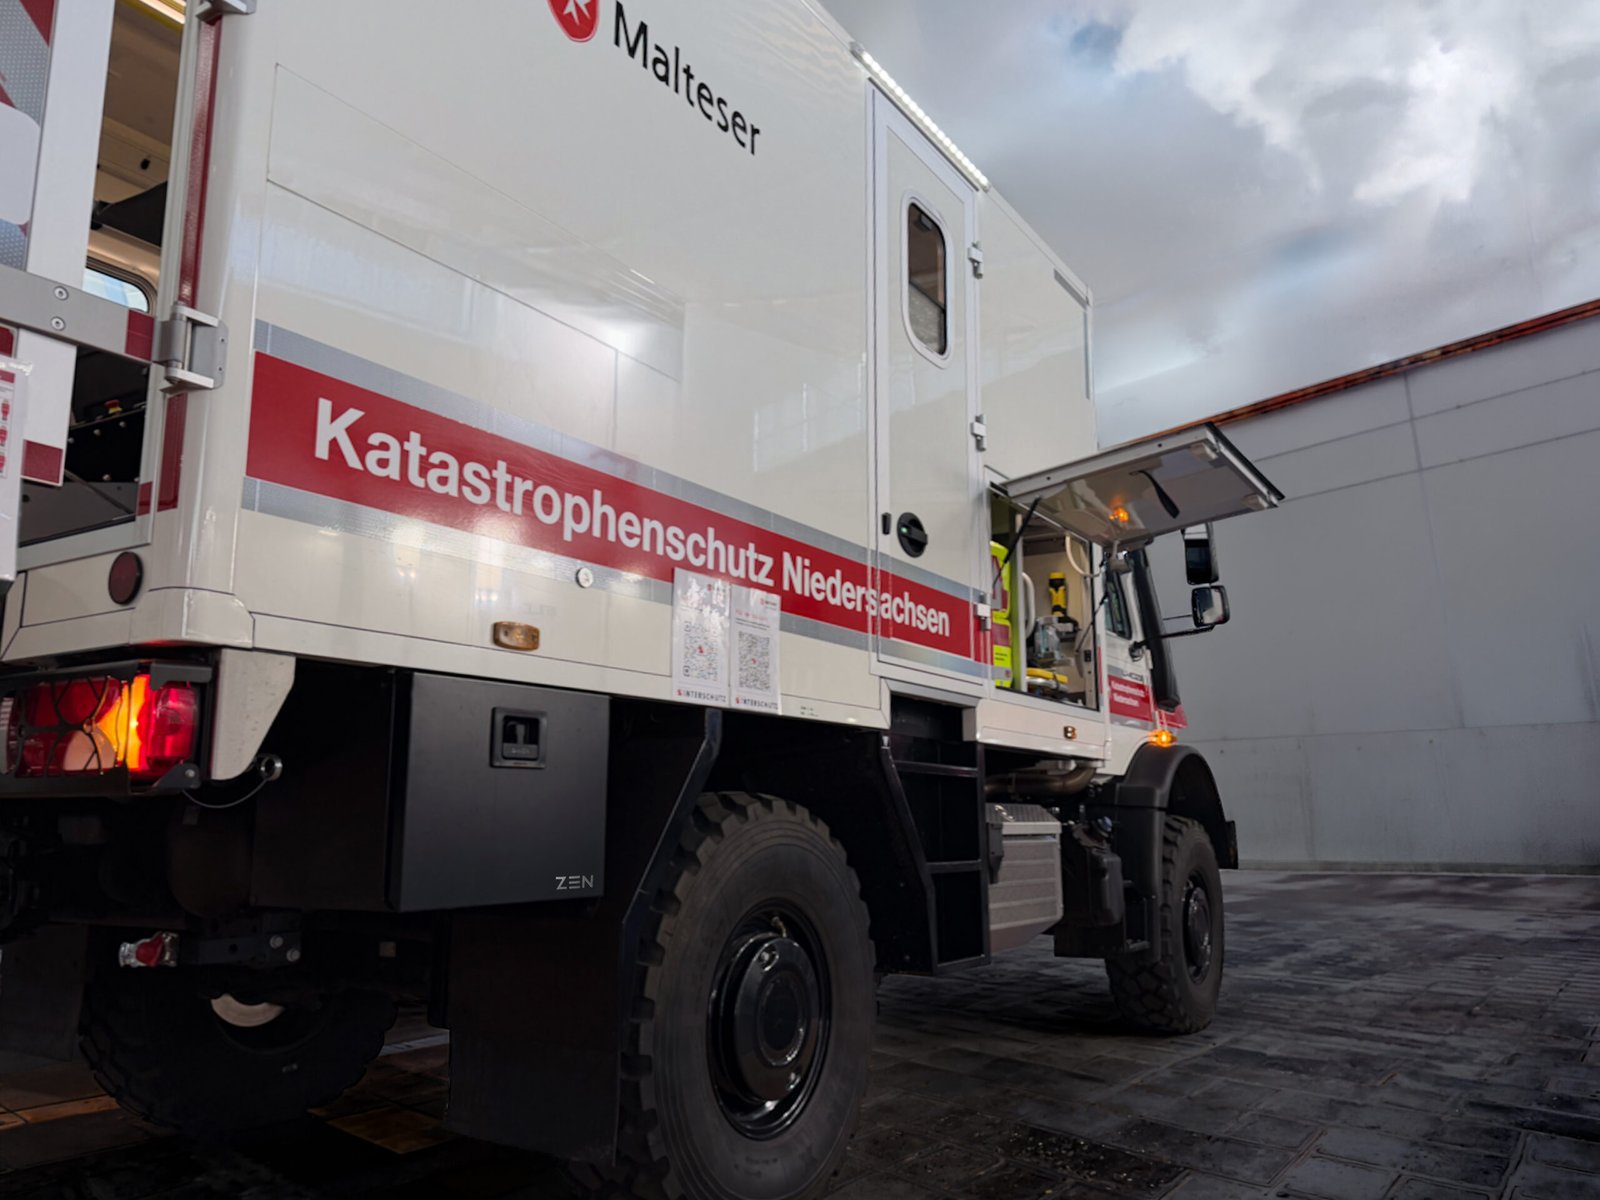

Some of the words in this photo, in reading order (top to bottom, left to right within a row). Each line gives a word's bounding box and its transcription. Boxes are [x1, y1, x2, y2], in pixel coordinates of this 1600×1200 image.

[613, 0, 760, 155] Malteser
[314, 398, 775, 587] Katastrophenschutz
[782, 551, 950, 637] Niedersachsen
[555, 875, 594, 890] ZEN
